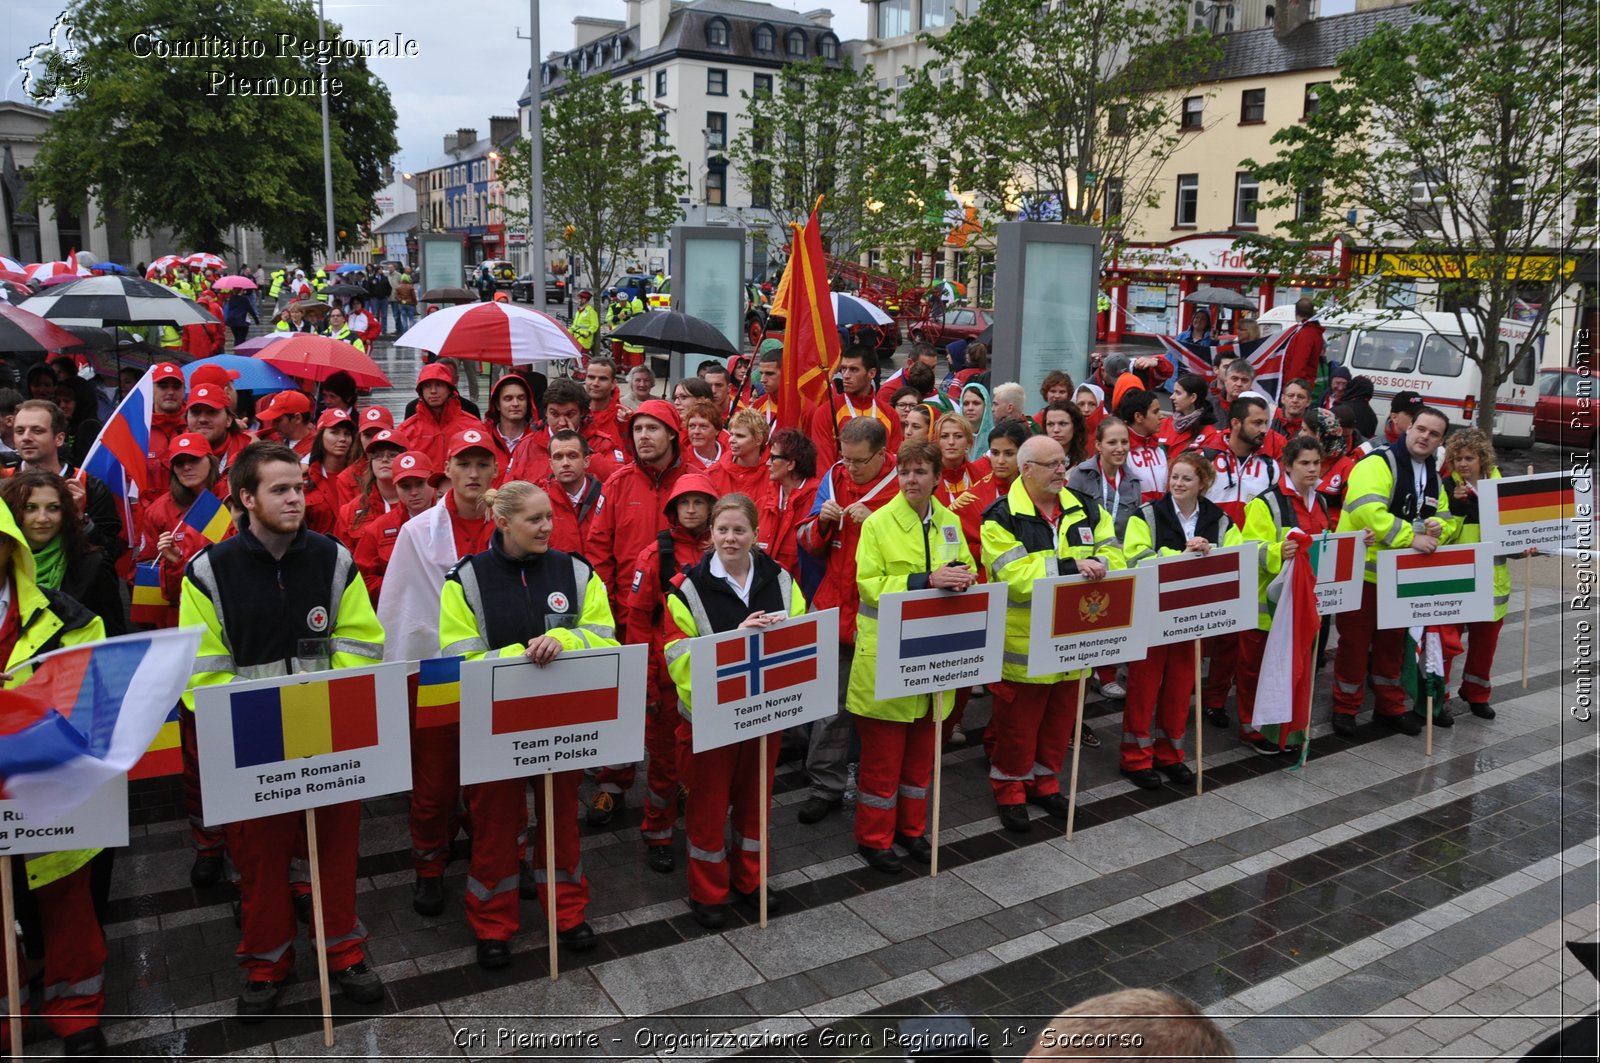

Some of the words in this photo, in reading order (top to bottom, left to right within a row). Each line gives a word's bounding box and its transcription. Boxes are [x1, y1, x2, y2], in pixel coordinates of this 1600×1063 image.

[1391, 378, 1432, 390] SOCIETY
[1131, 449, 1161, 468] CRI
[1214, 455, 1261, 478] CRI
[1501, 539, 1523, 547] Team
[1525, 533, 1577, 545] Deutschland
[1507, 528, 1530, 536] Team
[1532, 525, 1569, 534] Germany
[1324, 588, 1337, 596] Italy
[1322, 599, 1337, 607] Italia
[1173, 614, 1198, 624] Team
[1200, 608, 1227, 619] Latvia
[1163, 625, 1205, 638] Komanda
[1207, 618, 1237, 630] Latvija
[1054, 643, 1077, 652] Team
[1079, 635, 1127, 648] Montenegro
[899, 664, 926, 674] Team
[929, 654, 984, 670] Netherlands
[1059, 655, 1075, 663] Тим
[1078, 651, 1099, 661] Црна
[1101, 648, 1120, 657] Гора
[903, 677, 930, 687] Team
[933, 668, 979, 683] Nederland
[734, 703, 762, 716] Team
[765, 692, 802, 709] Norway
[734, 714, 772, 730] Teamet
[774, 705, 803, 719] Norge
[512, 738, 549, 750] Team
[554, 730, 599, 745] Poland
[513, 754, 550, 766] Team
[554, 747, 597, 760] Polska
[257, 771, 296, 785] Team
[301, 759, 361, 778] Romania
[255, 787, 301, 802] Echipa
[306, 774, 366, 793] România
[15, 826, 75, 838] России
